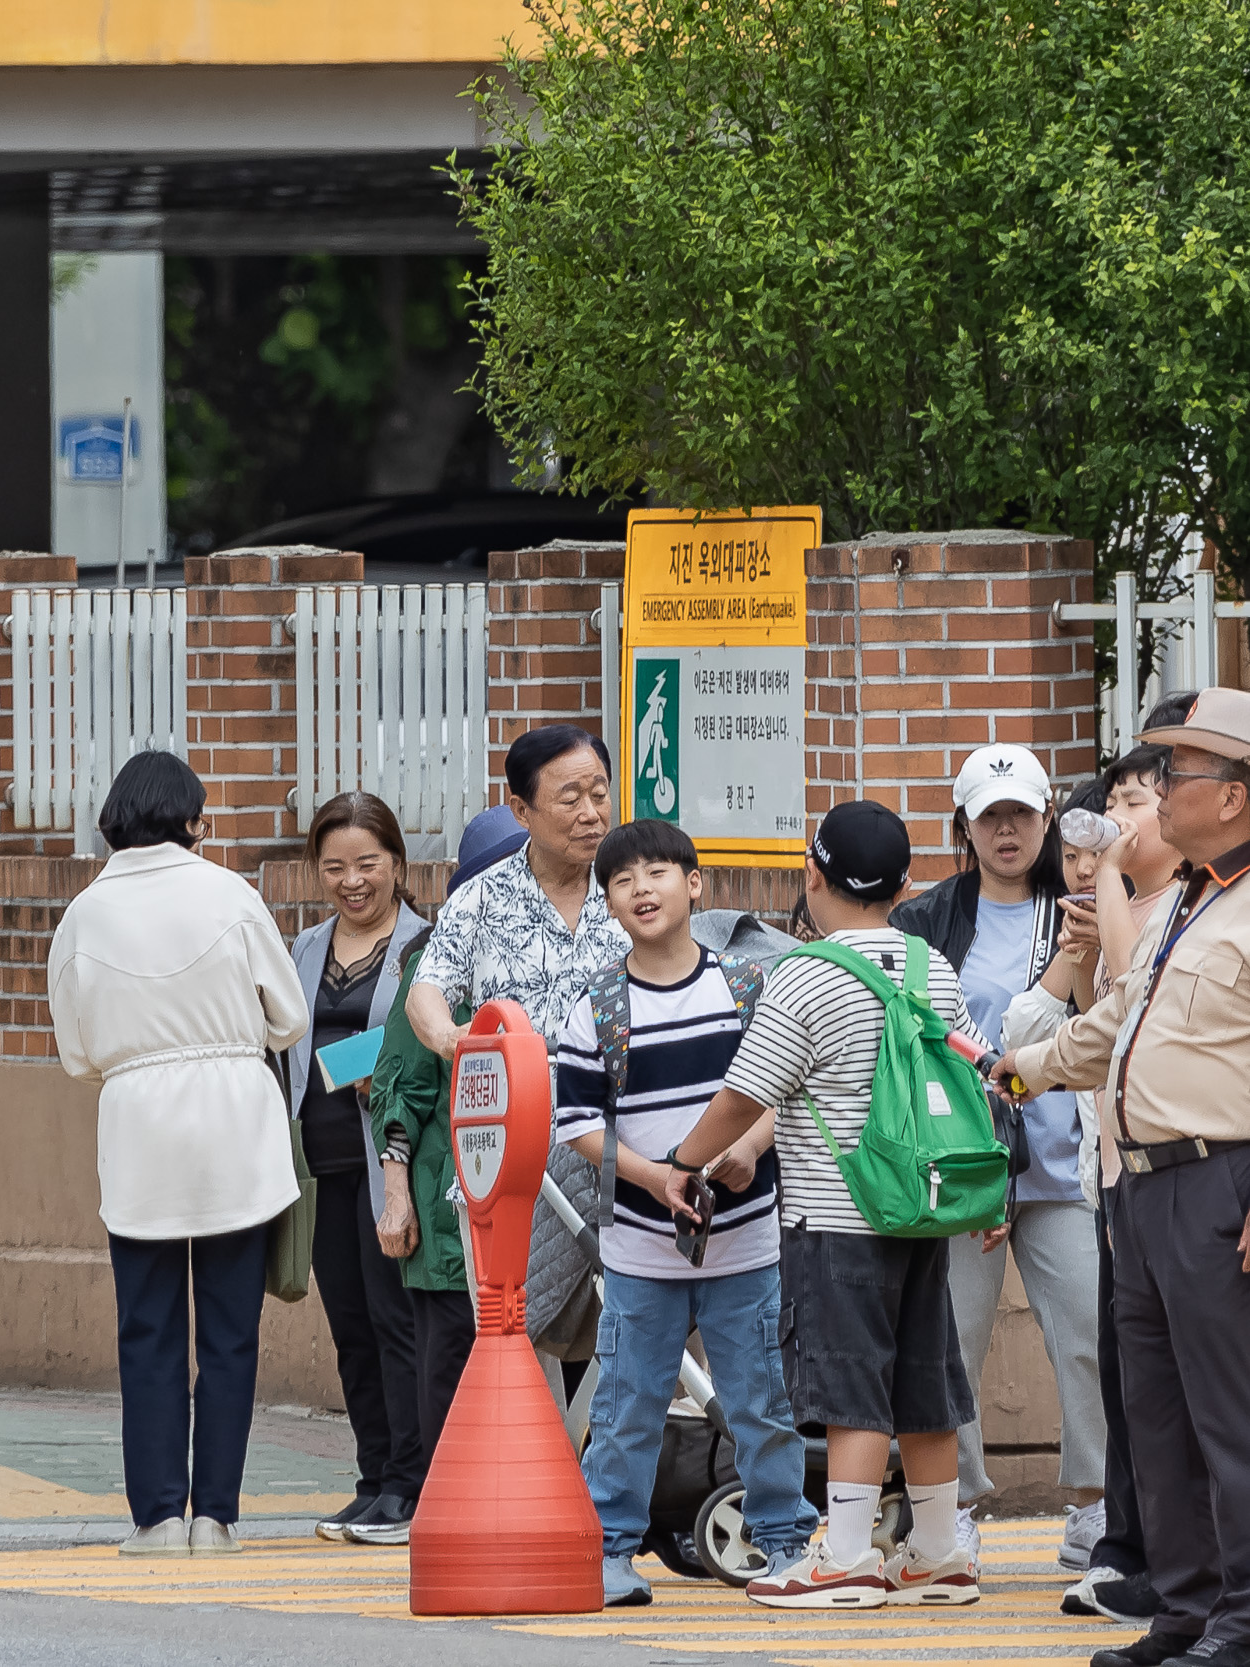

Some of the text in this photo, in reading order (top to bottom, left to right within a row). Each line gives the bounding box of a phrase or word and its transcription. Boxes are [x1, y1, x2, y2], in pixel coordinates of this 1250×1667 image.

[669, 539, 771, 585] 지진 옥외대피장소
[642, 595, 797, 625] EMERGENCY ASSEMBLY AREA (Earthquake)
[694, 668, 790, 695] 이곳은 지진 발생에 대비하여
[694, 714, 790, 741] 지정된 긴급 대피장소입니다.
[460, 1072, 499, 1110] 무단횡단금지
